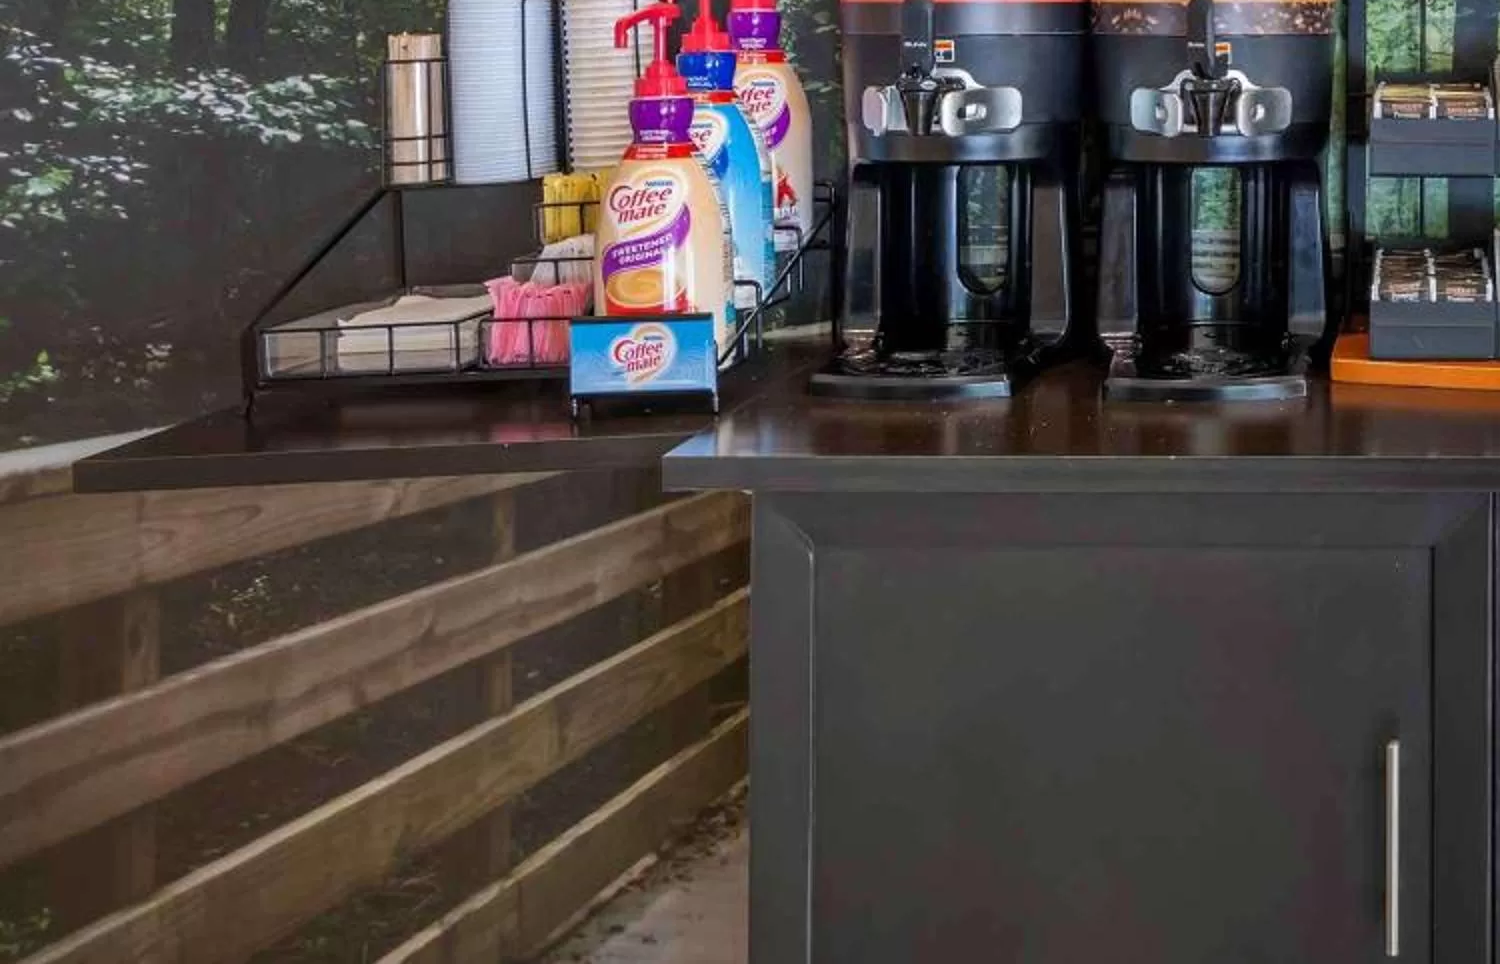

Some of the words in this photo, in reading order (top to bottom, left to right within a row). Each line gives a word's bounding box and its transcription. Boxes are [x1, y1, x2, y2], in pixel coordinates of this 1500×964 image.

[609, 185, 673, 214] Coffee
[617, 202, 667, 225] mate
[614, 338, 663, 364] Coffee
